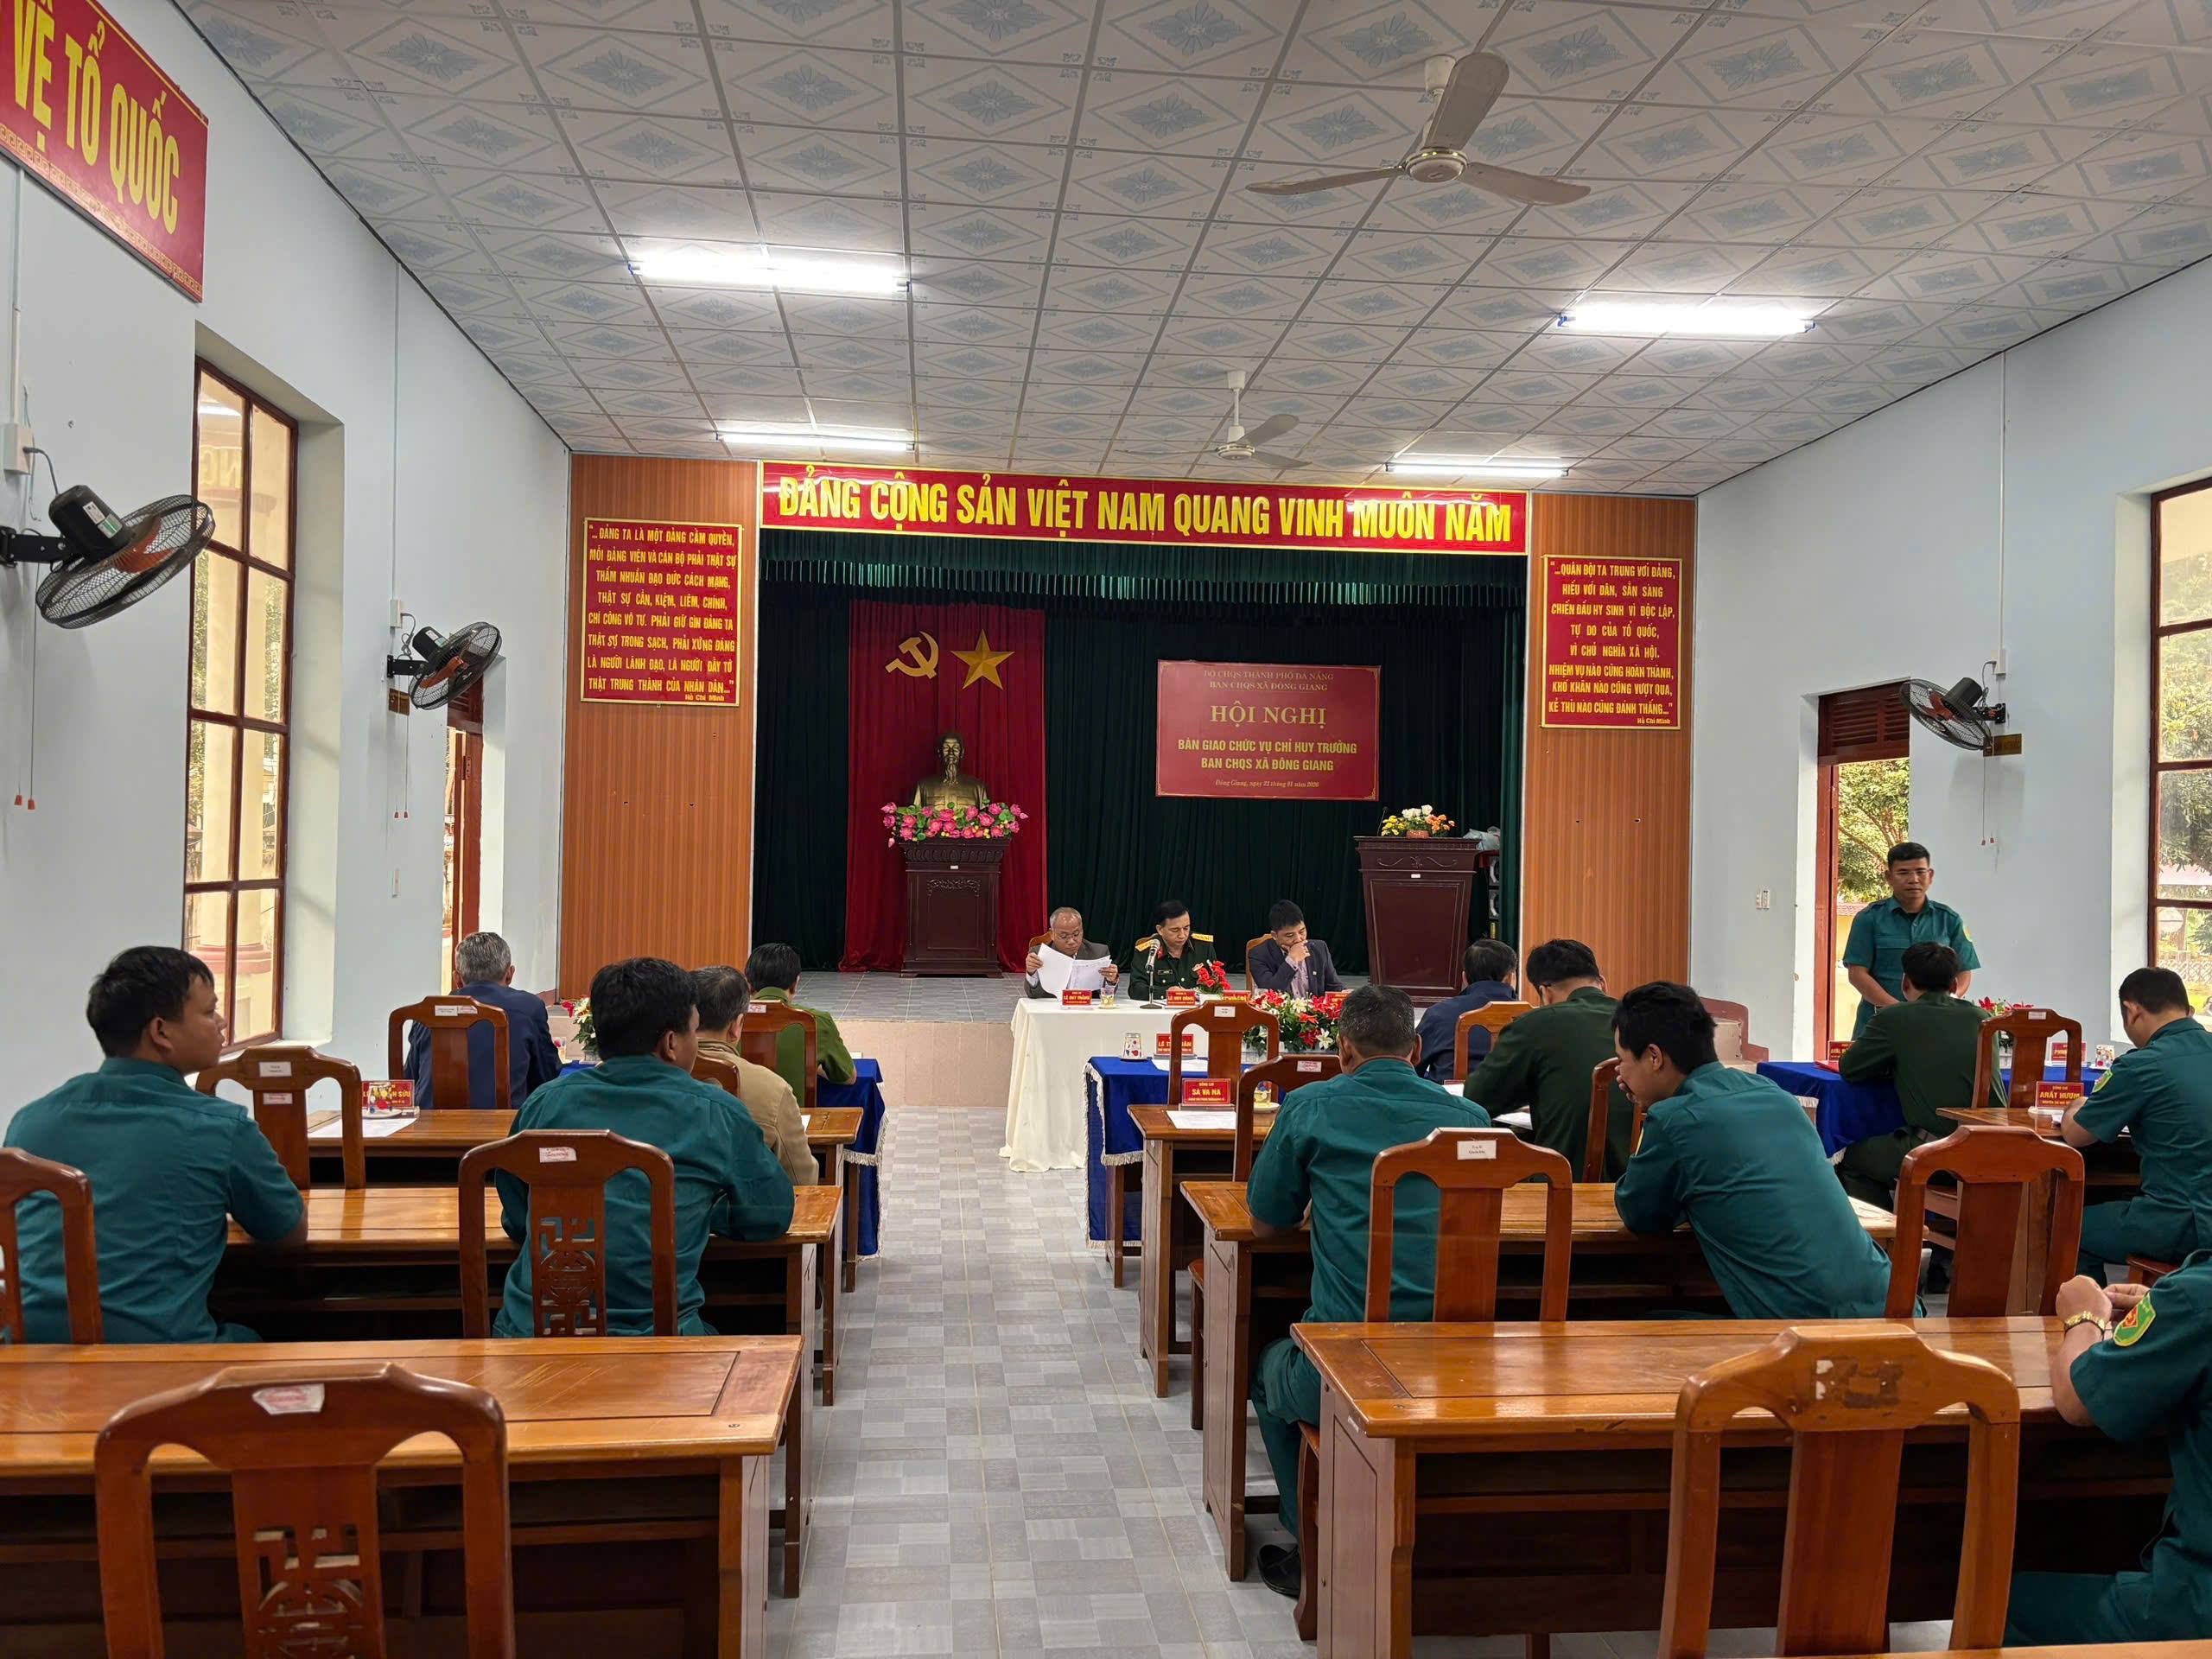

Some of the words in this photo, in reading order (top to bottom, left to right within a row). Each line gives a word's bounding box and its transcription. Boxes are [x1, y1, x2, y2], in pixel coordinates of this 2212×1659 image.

[65, 20, 105, 166] TỔ
[110, 83, 180, 234] QUỐC
[779, 465, 861, 518] ĐẢNG
[870, 472, 947, 531] CỘNG
[957, 474, 1017, 525] SẢN
[1027, 480, 1088, 537] VIỆT
[1097, 492, 1164, 531] NAM
[1174, 493, 1269, 537] QUANG
[1278, 498, 1344, 537] VINH
[1351, 492, 1435, 540] MUÔN
[1445, 495, 1511, 542] NĂM
[622, 529, 632, 540] TA
[634, 527, 645, 541] LÀ
[647, 528, 664, 543] MỘT
[666, 527, 686, 543] ĐẢNG
[607, 546, 626, 562] ĐẢNG
[630, 549, 645, 563] VIÊN
[648, 550, 657, 563] VÀ
[658, 550, 673, 564] CÁN
[675, 550, 685, 567] BỘ
[687, 550, 704, 566] PHẢI
[706, 553, 724, 569] THẬT
[726, 555, 737, 569] SỰ
[1583, 562, 1596, 578] ĐỘI
[1597, 565, 1607, 576] TA
[1610, 565, 1636, 577] TRUNG
[1637, 563, 1649, 577] VỚI
[648, 573, 663, 586] ĐẠO
[666, 570, 681, 585] ĐỨC
[684, 571, 704, 587] CÁCH
[708, 576, 730, 589] MẠNG,
[1583, 581, 1596, 595] VỚI
[598, 590, 616, 606] THẬT
[620, 592, 631, 607] SỰ
[1551, 600, 1575, 615] CHIẾN
[1576, 600, 1592, 614] ĐẤU
[1593, 605, 1603, 615] HY
[1605, 605, 1624, 616] SINH
[1628, 602, 1636, 616] VÌ
[1640, 603, 1656, 619] ĐỘC
[588, 611, 601, 624] CHÍ
[603, 611, 622, 625] CÔNG
[624, 612, 633, 626] VÔ
[651, 612, 670, 627] PHẢI
[703, 614, 722, 630] ĐẢNG
[724, 619, 733, 631] TA
[1570, 624, 1581, 638] TỰ
[1586, 625, 1597, 636] DO
[1601, 621, 1618, 637] CỦA
[588, 632, 606, 648] THẬT
[607, 634, 618, 649] SỰ
[621, 635, 644, 648] TRONG
[673, 634, 690, 650] PHẢI
[1581, 641, 1597, 657] CHỦ
[588, 654, 597, 668] LÀ
[588, 676, 607, 692] THẬT
[610, 678, 633, 691] TRUNG
[638, 677, 663, 691] THÀNH
[666, 677, 681, 692] CỦA
[1552, 679, 1567, 693] KHÓ
[1655, 684, 1673, 696] QUA,
[1210, 700, 1256, 728] HỘI
[1262, 706, 1326, 729] NGHỊ
[1178, 737, 1199, 751] BÀN
[1203, 740, 1226, 751] GIAO
[1229, 739, 1255, 752] CHỨC
[1259, 741, 1272, 754] VỤ
[1274, 738, 1292, 752] CHỈ
[1294, 742, 1313, 753] HUY
[1318, 740, 1357, 753] TRƯỞNG
[1201, 758, 1223, 769] BAN
[1225, 758, 1252, 770] CHQS
[1255, 756, 1269, 770] XÃ
[1272, 757, 1300, 770] ĐÔNG
[1302, 760, 1333, 771] GIANG
